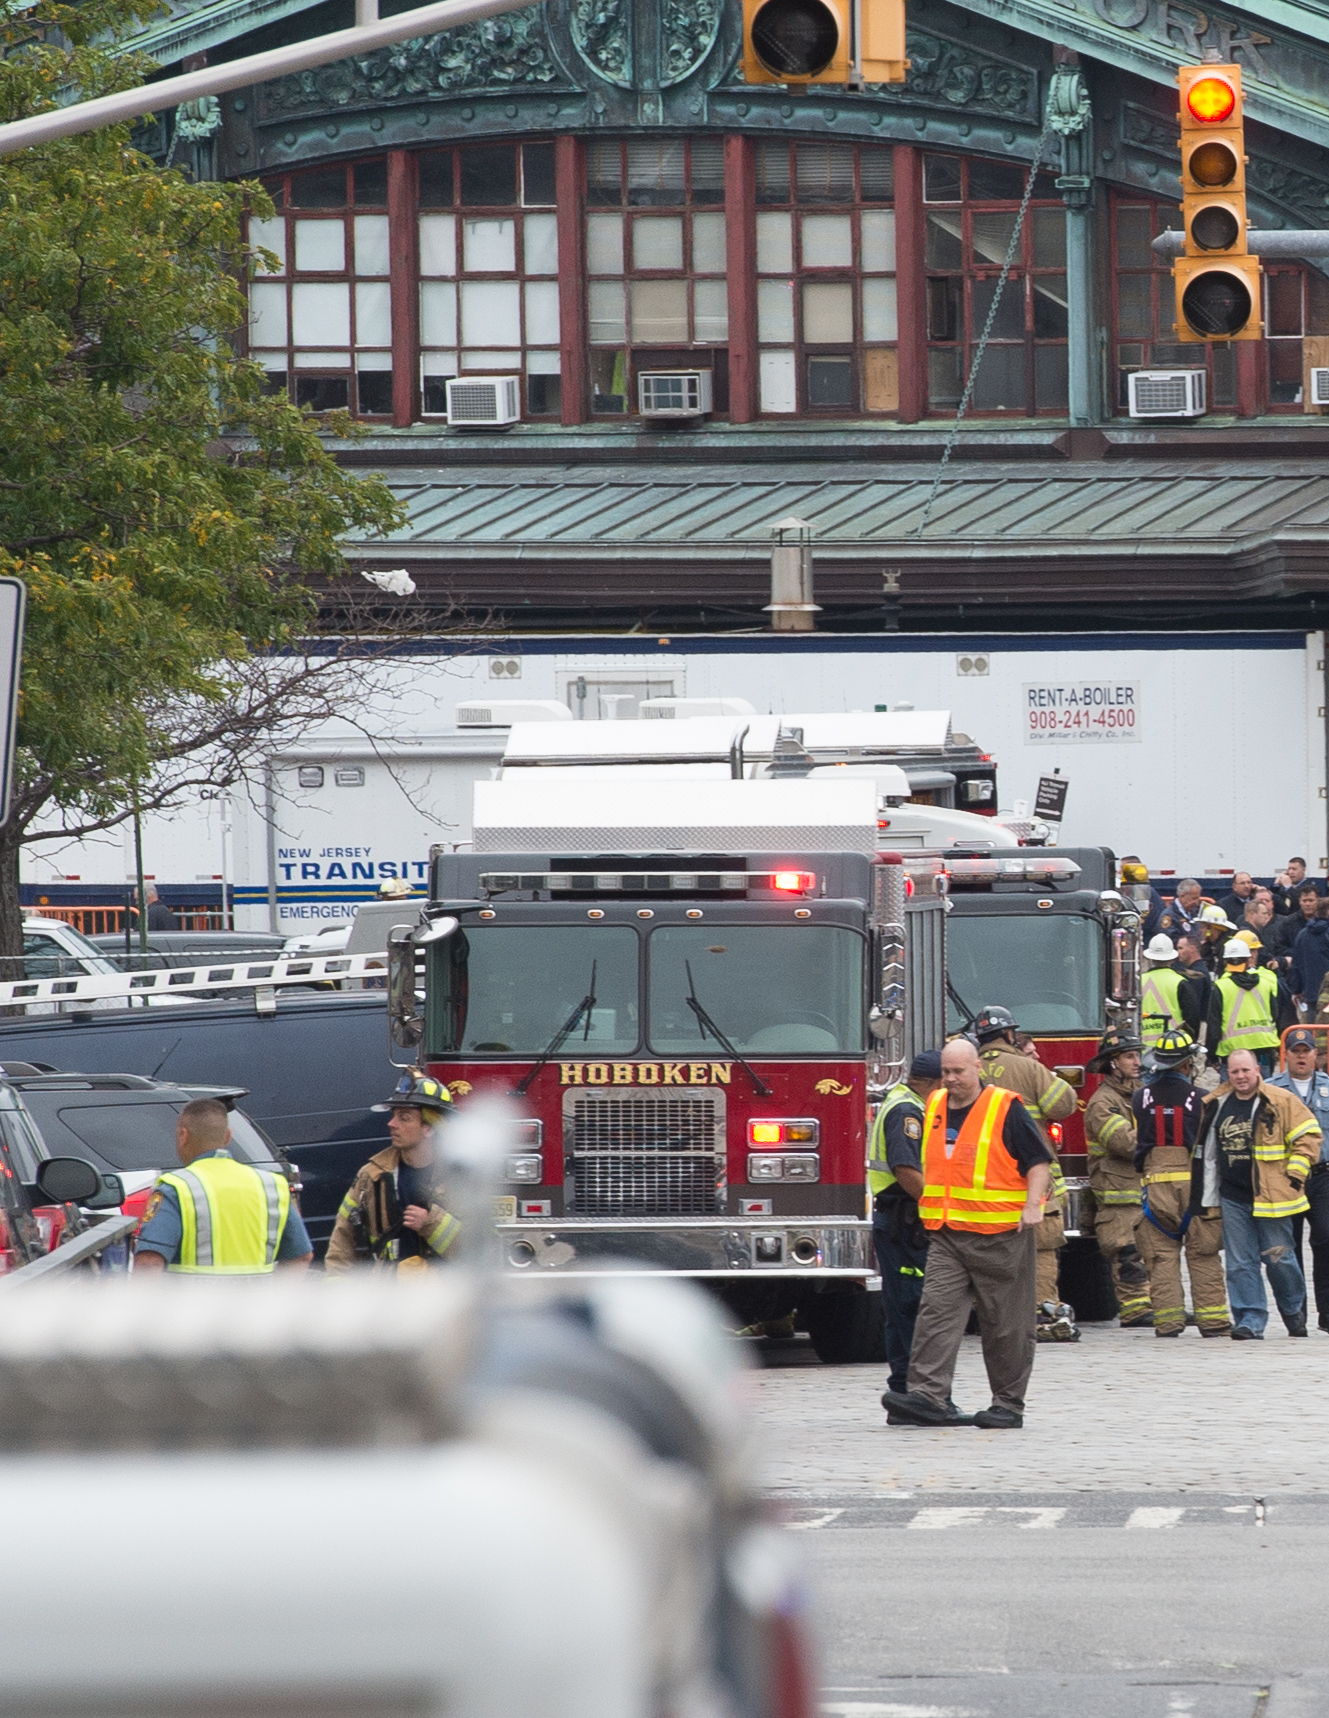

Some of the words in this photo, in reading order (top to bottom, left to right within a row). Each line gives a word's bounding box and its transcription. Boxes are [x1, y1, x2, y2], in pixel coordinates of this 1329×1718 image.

[1053, 0, 1278, 88] ORK
[1027, 686, 1135, 707] RENT-A-BOILER
[1029, 708, 1136, 730] 908-241-4500
[278, 848, 311, 859] NEW
[319, 847, 372, 858] JERSEY
[279, 861, 430, 881] TRANSIT
[280, 904, 360, 919] EMERGENC
[559, 1063, 733, 1085] HOBOKEN
